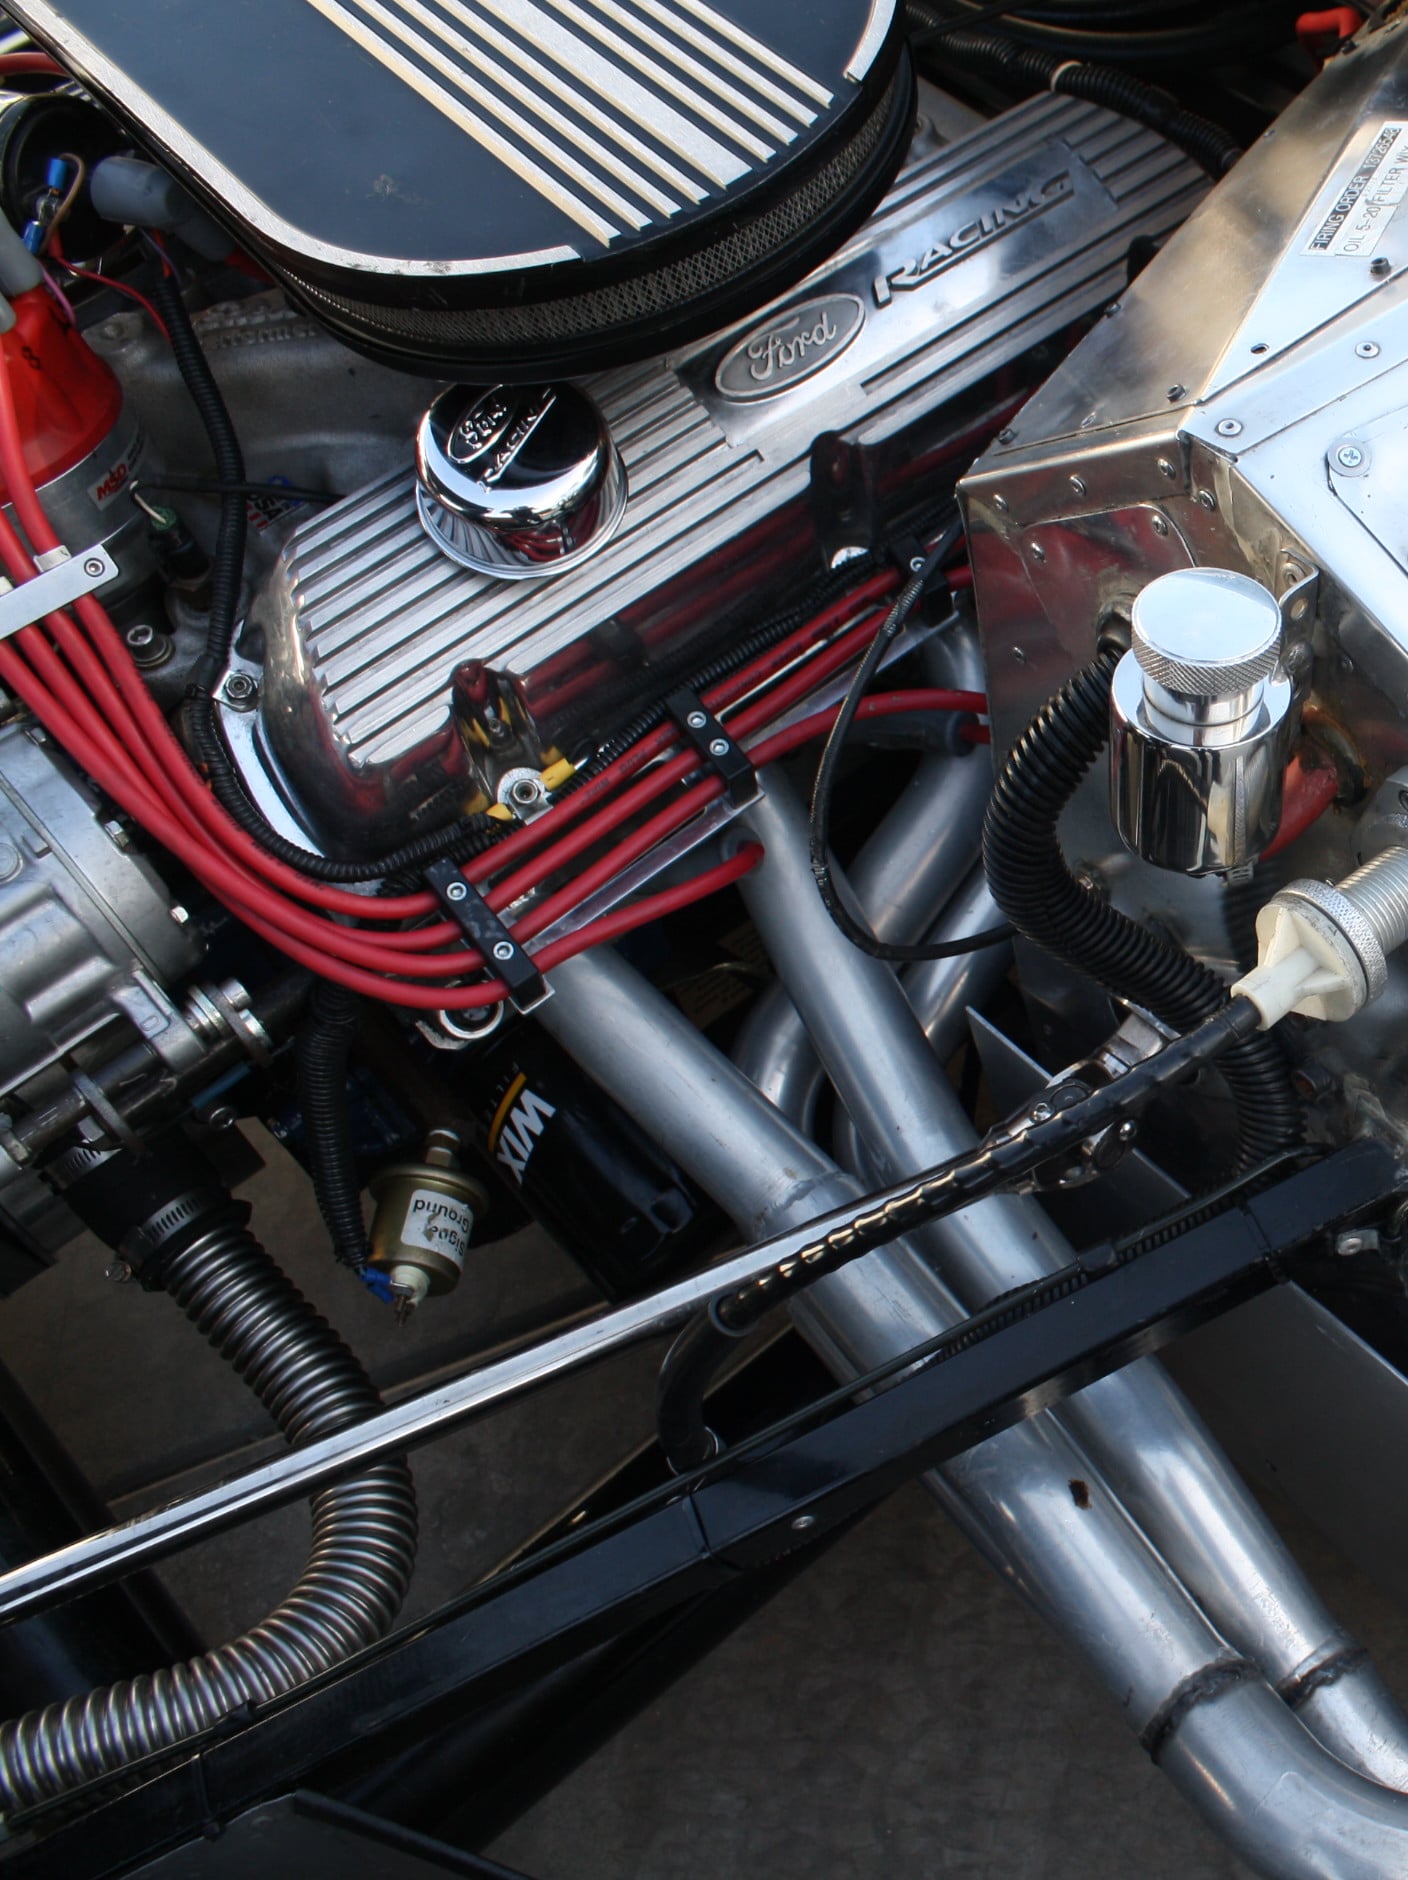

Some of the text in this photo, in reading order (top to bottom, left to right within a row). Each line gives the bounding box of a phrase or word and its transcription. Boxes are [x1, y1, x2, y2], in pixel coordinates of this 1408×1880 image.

[1311, 215, 1345, 250] FIRING
[1336, 174, 1370, 211] ORDER
[1343, 228, 1365, 252] OIL
[1374, 167, 1405, 202] FILTER
[748, 170, 1077, 381] Ford RACING
[497, 1089, 556, 1184] WIX
